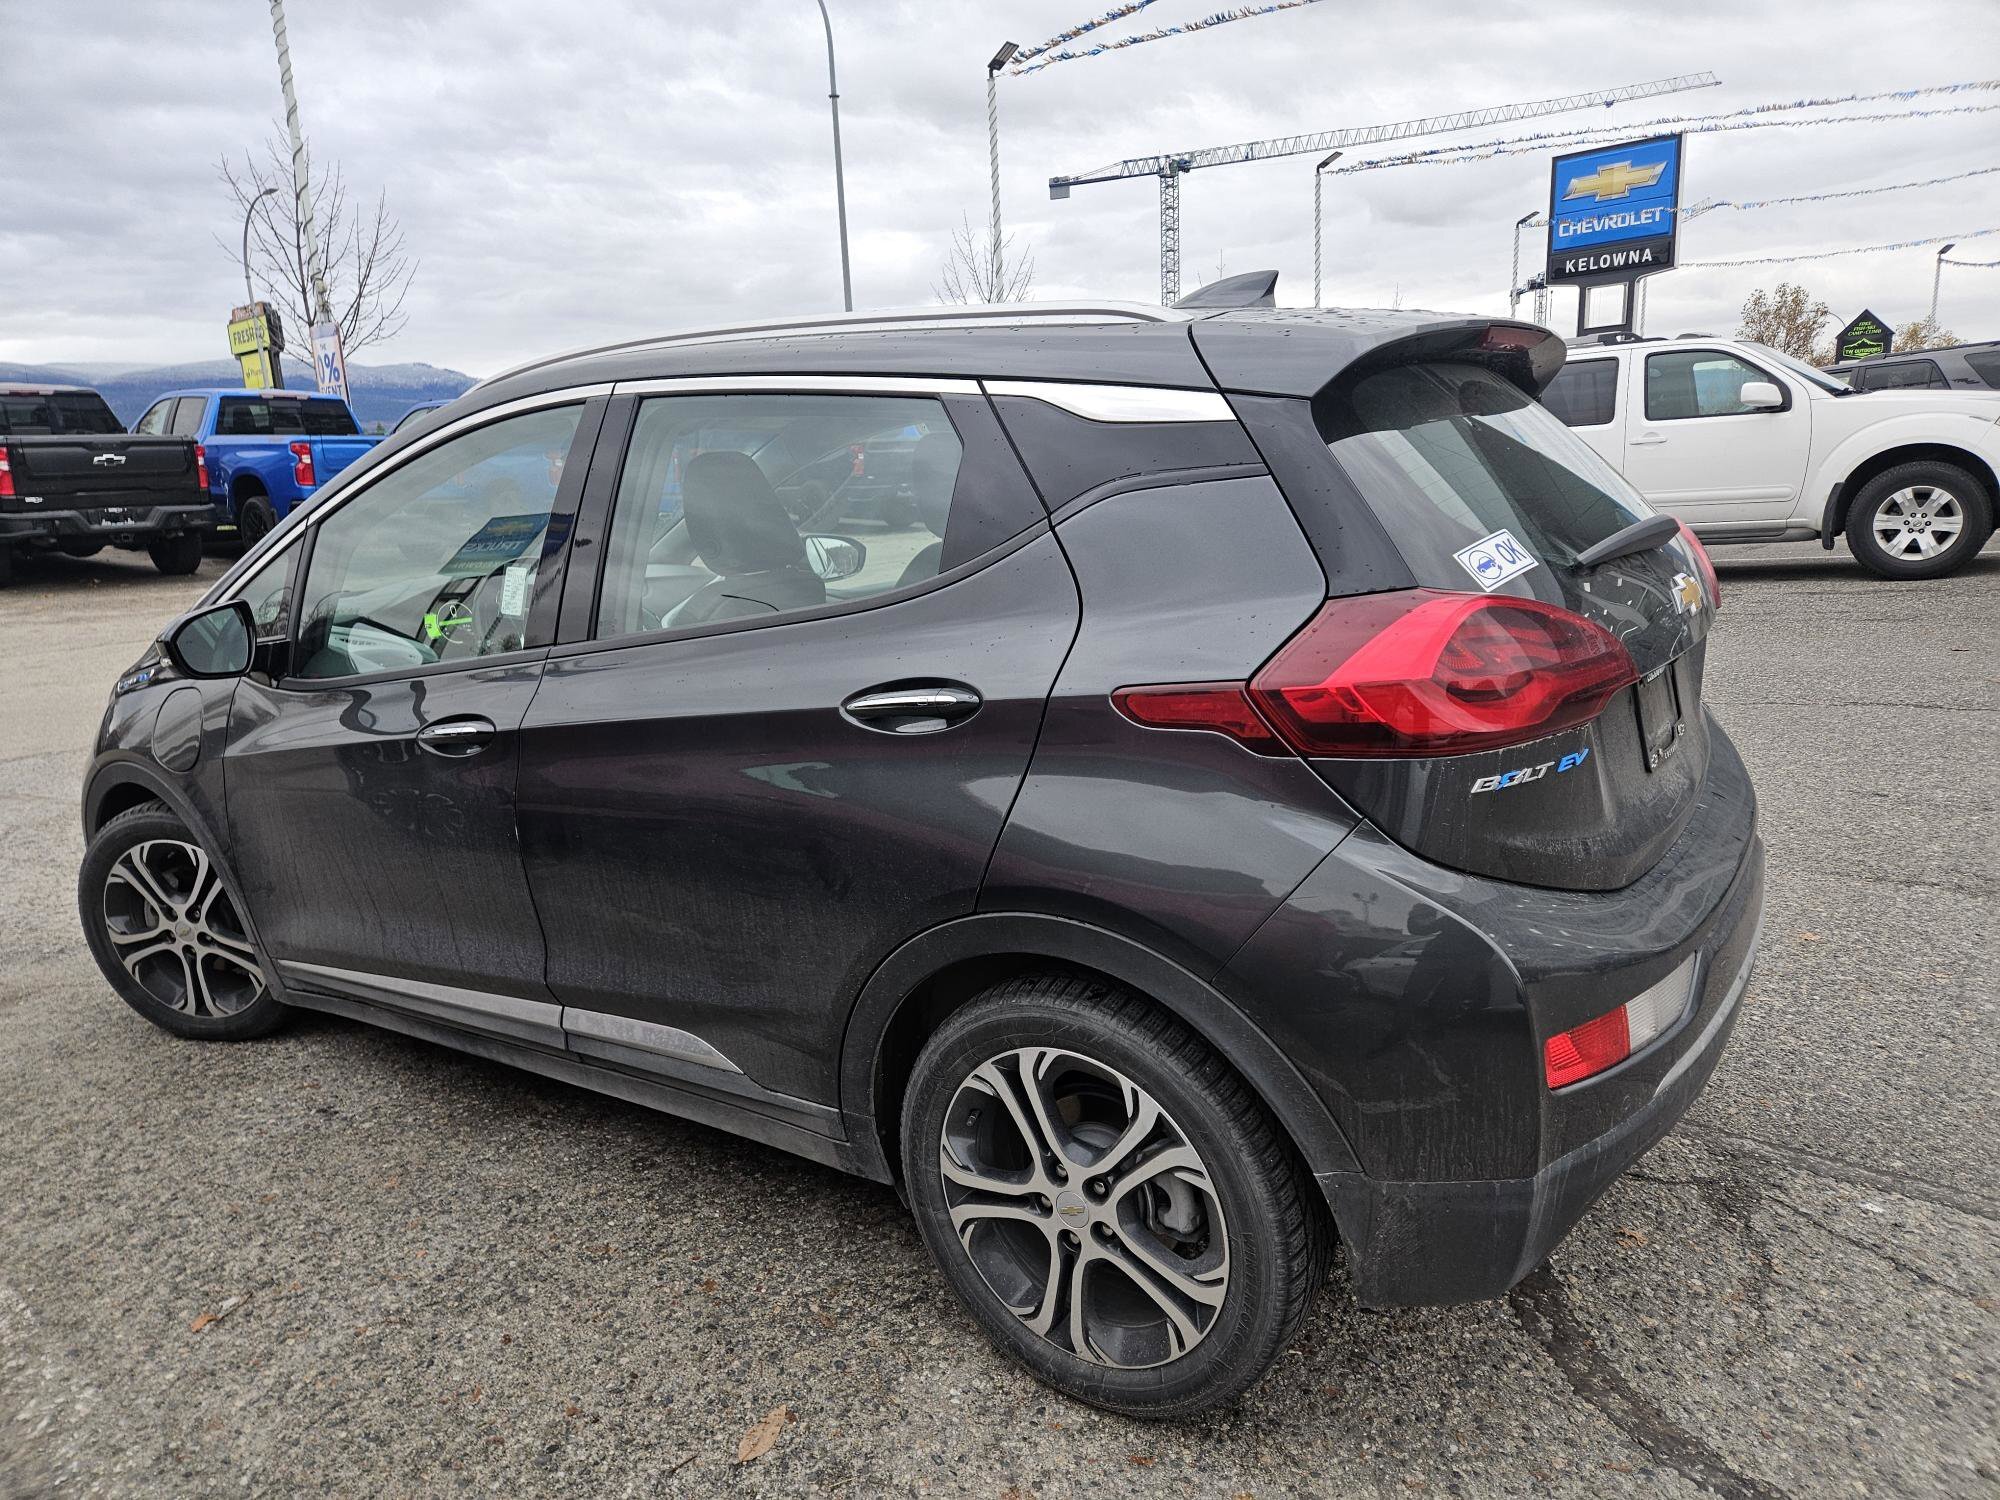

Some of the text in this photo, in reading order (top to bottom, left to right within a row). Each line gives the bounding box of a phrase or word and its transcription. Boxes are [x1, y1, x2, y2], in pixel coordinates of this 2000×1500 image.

[1558, 207, 1664, 237] CHEVROLET
[1565, 247, 1653, 273] KELOWNA
[317, 352, 341, 384] 0%
[1495, 538, 1527, 564] OK
[1471, 748, 1589, 793] BOLT EV
